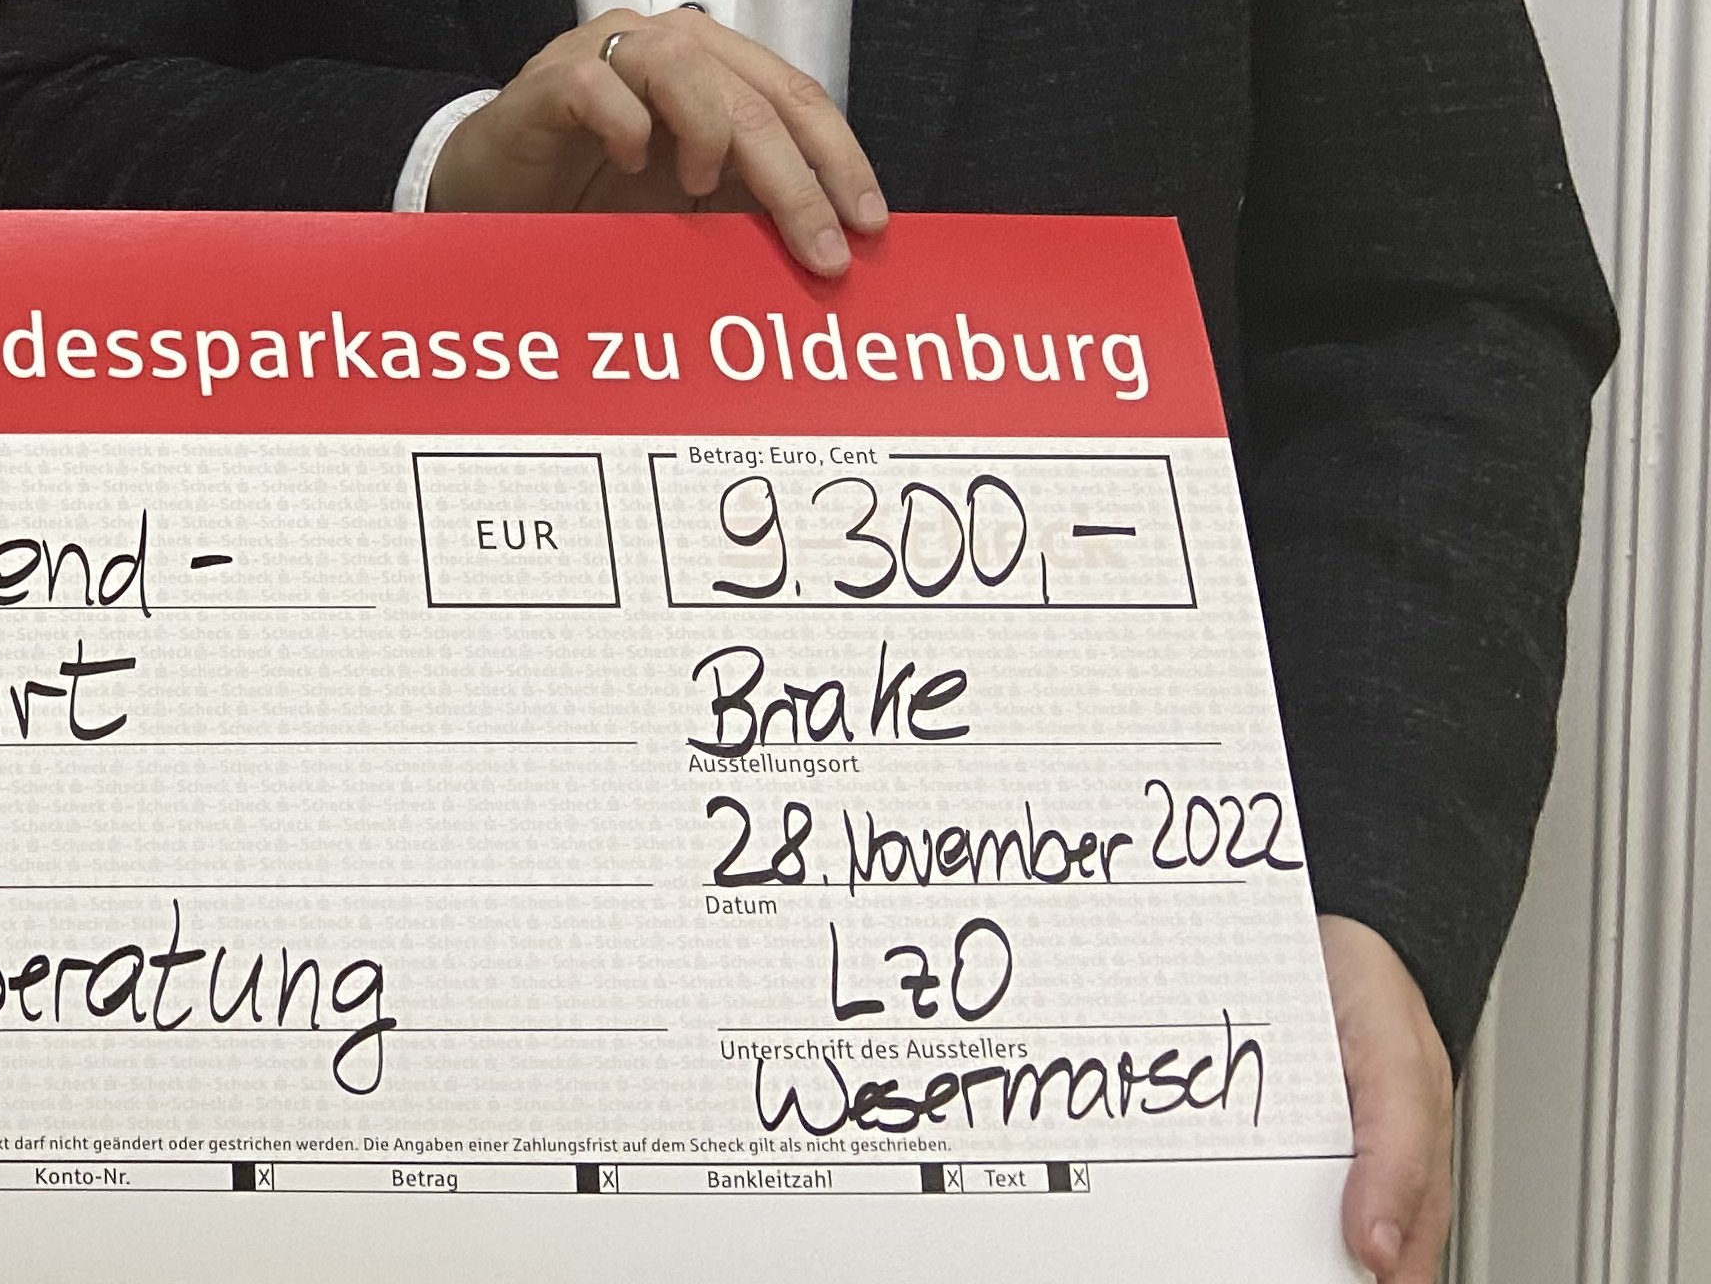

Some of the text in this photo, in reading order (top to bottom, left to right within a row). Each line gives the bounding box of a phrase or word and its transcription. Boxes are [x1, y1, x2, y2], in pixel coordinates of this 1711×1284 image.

[587, 328, 680, 382] zu
[708, 313, 1151, 402] Oldenburg
[689, 446, 878, 470] Betrag: Euro, Cent
[476, 520, 560, 551] EUR
[686, 640, 971, 758] Brake
[688, 753, 860, 777] Ausstellungsort
[843, 801, 1133, 896] November
[1144, 778, 1304, 870] 2022
[705, 895, 777, 915] Datum
[829, 917, 1014, 1023] LzO
[720, 1037, 1029, 1060] Unterschrift des Ausstellers
[756, 1009, 1265, 1137] Wesermarsch
[14, 1136, 46, 1150] darf
[49, 1136, 89, 1150] nicht
[93, 1136, 164, 1154] geändert
[168, 1136, 204, 1151] oder
[208, 1137, 291, 1154] gestrichen
[295, 1137, 359, 1152] werden.
[363, 1137, 389, 1151] Die
[393, 1137, 464, 1155] Angaben
[468, 1138, 509, 1152] einer
[513, 1137, 619, 1156] Zahlungsfrist
[622, 1138, 647, 1152] auf
[651, 1138, 685, 1152] dem
[690, 1137, 745, 1152] Scheck
[749, 1137, 776, 1156] gilt
[779, 1137, 802, 1152] als
[806, 1138, 846, 1152] nicht
[850, 1137, 952, 1156] geschrieben.
[34, 1167, 131, 1186] Konto-Nr.
[257, 1168, 272, 1186] X
[391, 1170, 459, 1191] Betrag
[602, 1169, 616, 1188] X
[707, 1169, 833, 1188] Bankleitzahl
[946, 1169, 960, 1188] X
[984, 1169, 1026, 1187] Text
[1073, 1168, 1086, 1187] X
